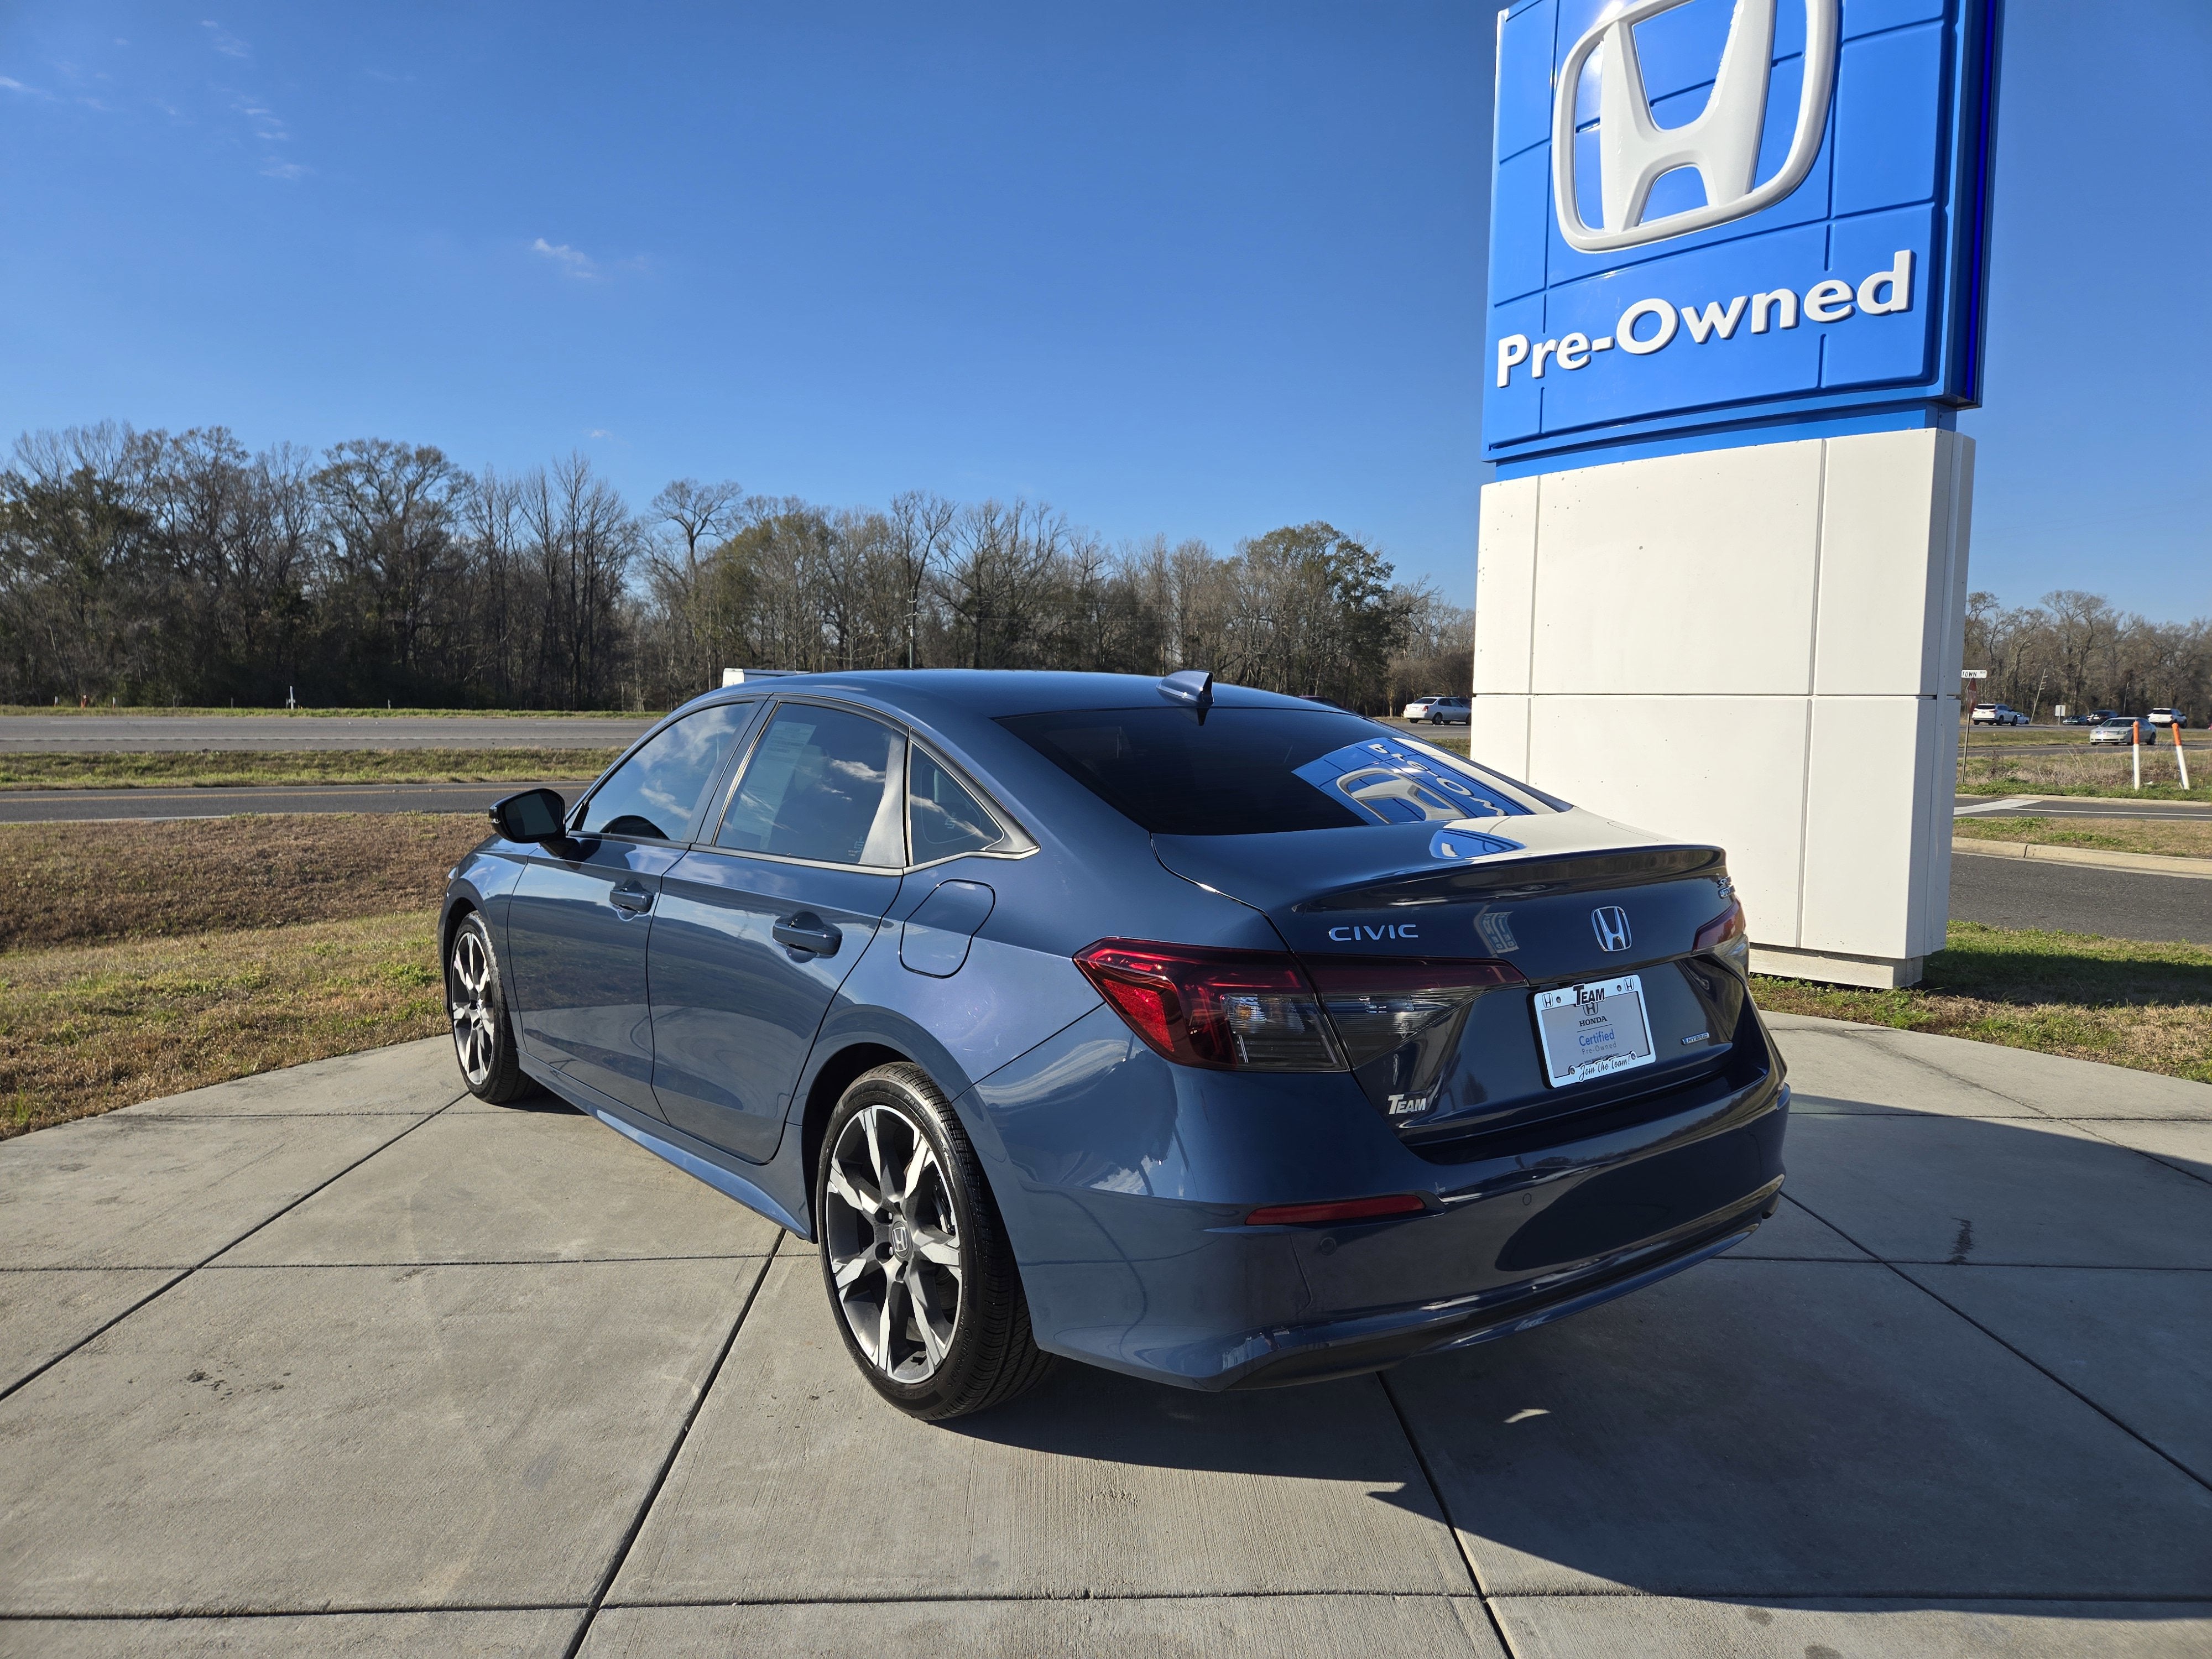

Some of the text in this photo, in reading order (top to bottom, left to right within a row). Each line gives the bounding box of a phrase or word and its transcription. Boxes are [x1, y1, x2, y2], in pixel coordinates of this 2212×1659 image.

[1496, 249, 1912, 387] Pre-Owned
[1328, 924, 1419, 941] CIVIC
[1573, 984, 1605, 1005] TEAM
[1579, 1016, 1608, 1027] HONDA
[1579, 1029, 1615, 1046] Certified
[1688, 1033, 1708, 1043] HYBRID
[1582, 1042, 1617, 1055] Pre-Owned
[1579, 1055, 1630, 1081] Join The Team!
[1388, 1094, 1426, 1114] TEAM
